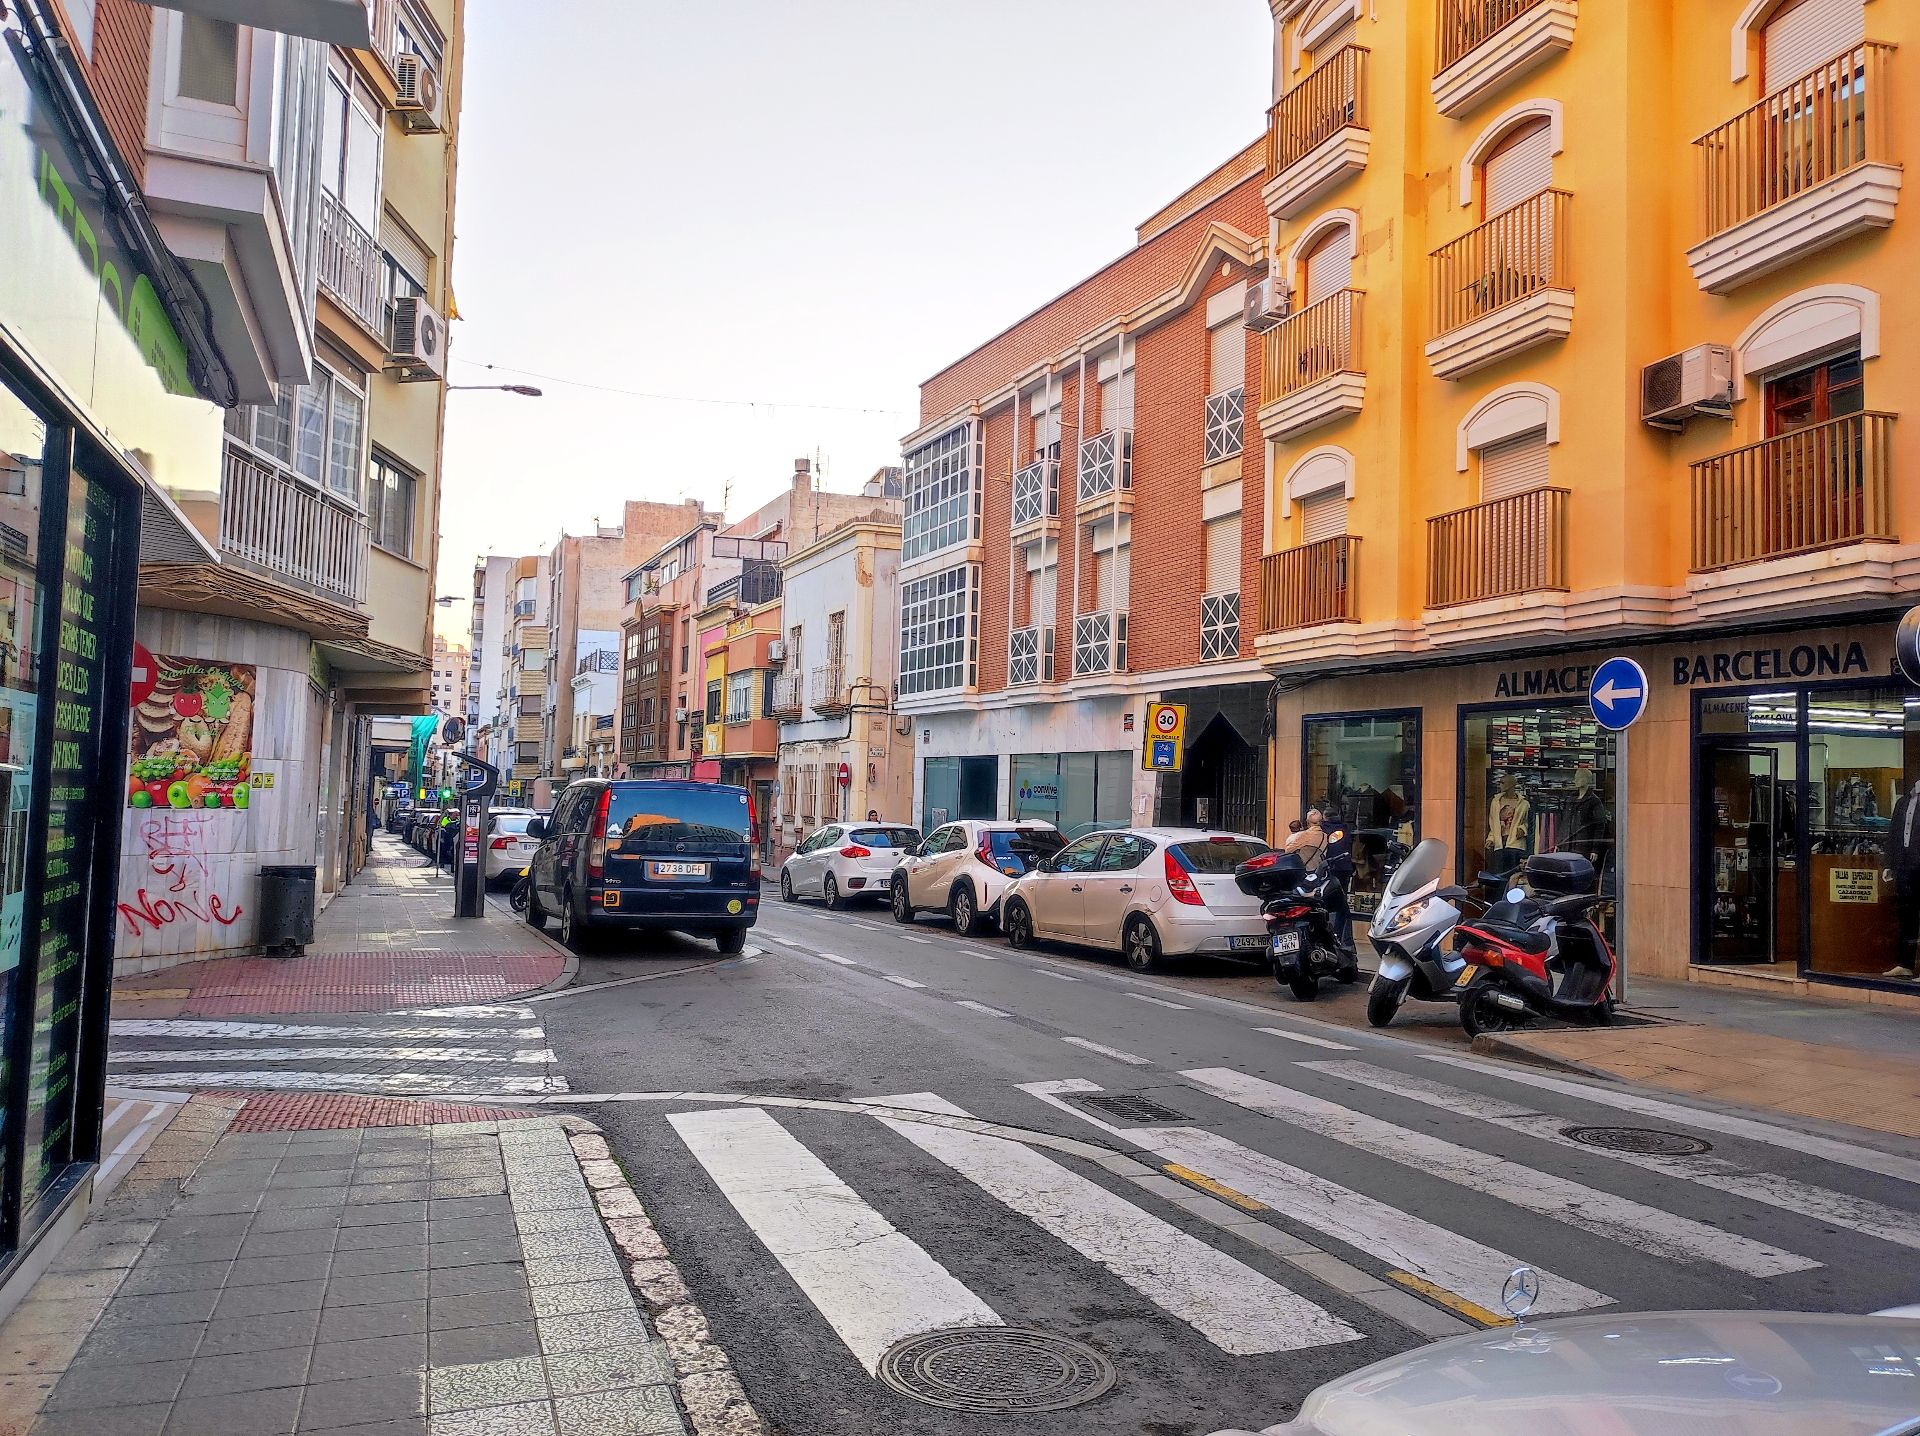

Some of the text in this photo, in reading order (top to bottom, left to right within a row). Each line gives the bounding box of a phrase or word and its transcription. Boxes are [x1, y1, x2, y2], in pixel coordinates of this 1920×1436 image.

[1673, 641, 1869, 686] BARCELONA
[1495, 664, 1597, 697] ALMACE
[1702, 702, 1750, 714] ALMACENES
[1159, 715, 1174, 725] 30
[470, 769, 481, 780] P
[660, 863, 683, 873] 2738
[1236, 937, 1255, 947] 2492
[1278, 933, 1297, 944] 8599
[1281, 942, 1296, 951] HKN
